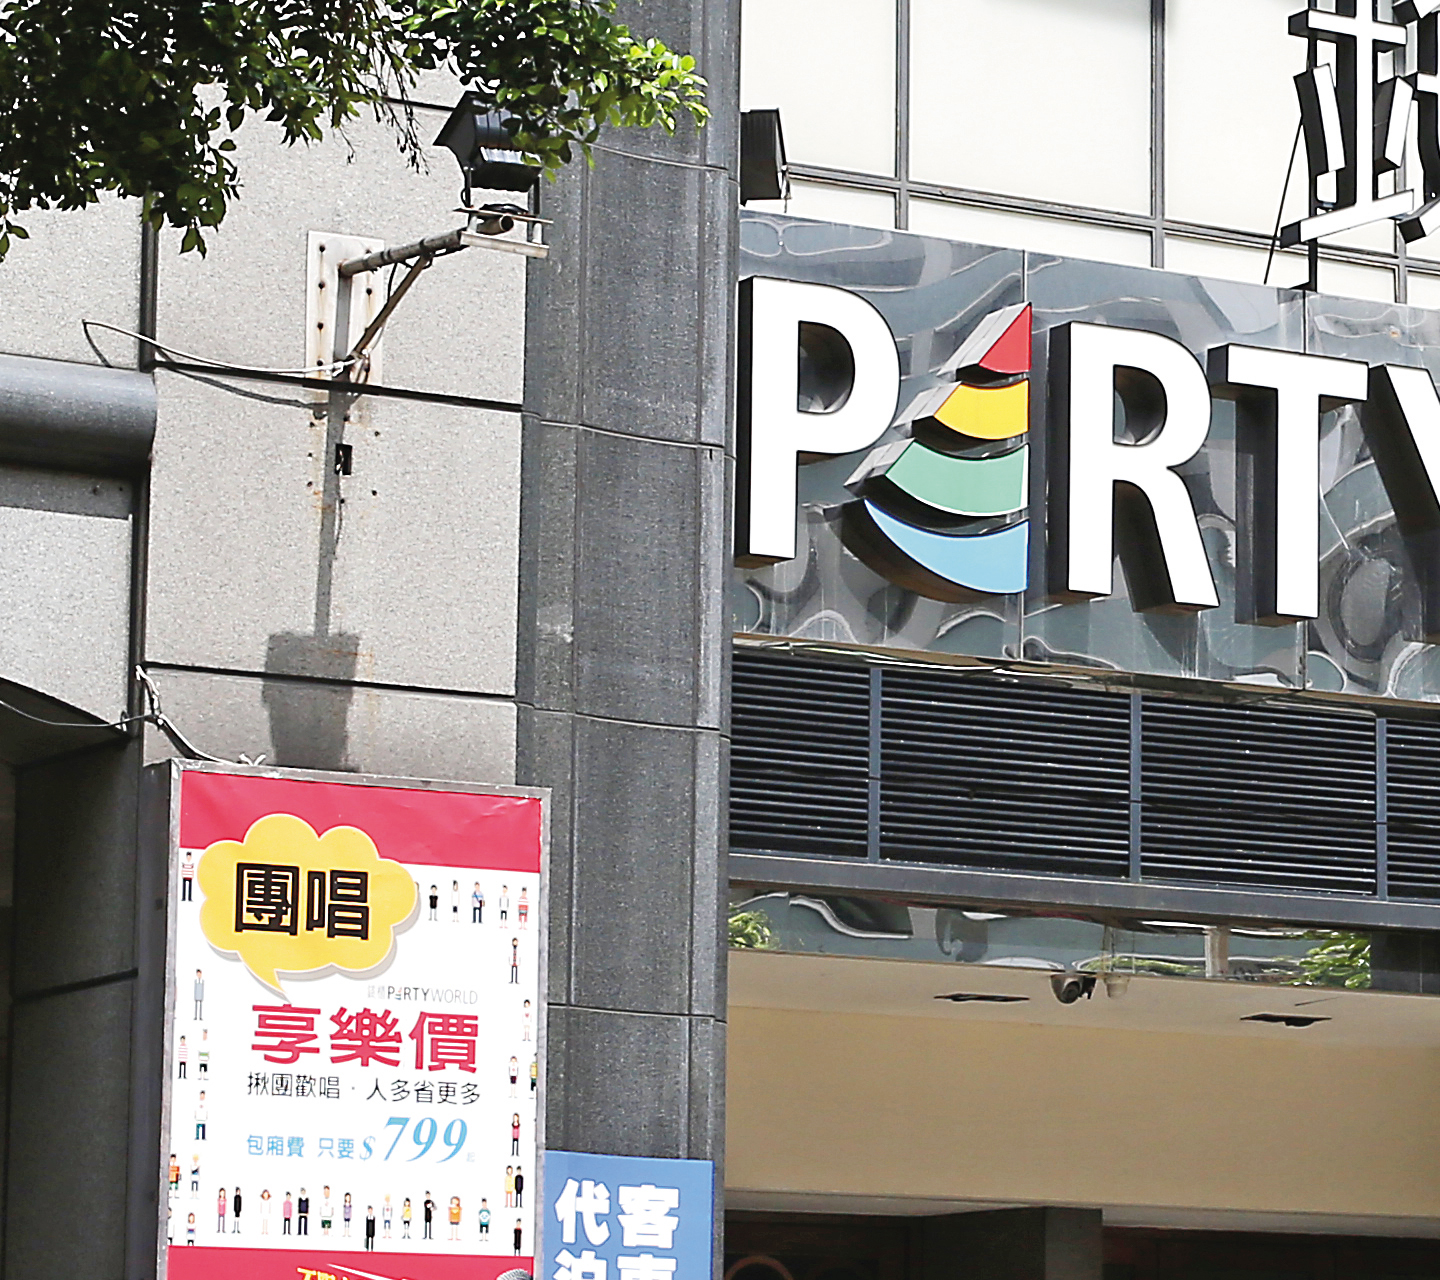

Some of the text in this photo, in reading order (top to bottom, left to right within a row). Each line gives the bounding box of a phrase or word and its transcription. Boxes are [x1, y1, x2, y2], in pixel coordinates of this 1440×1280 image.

[235, 862, 369, 941] 團唱
[252, 1003, 479, 1073] 享樂價
